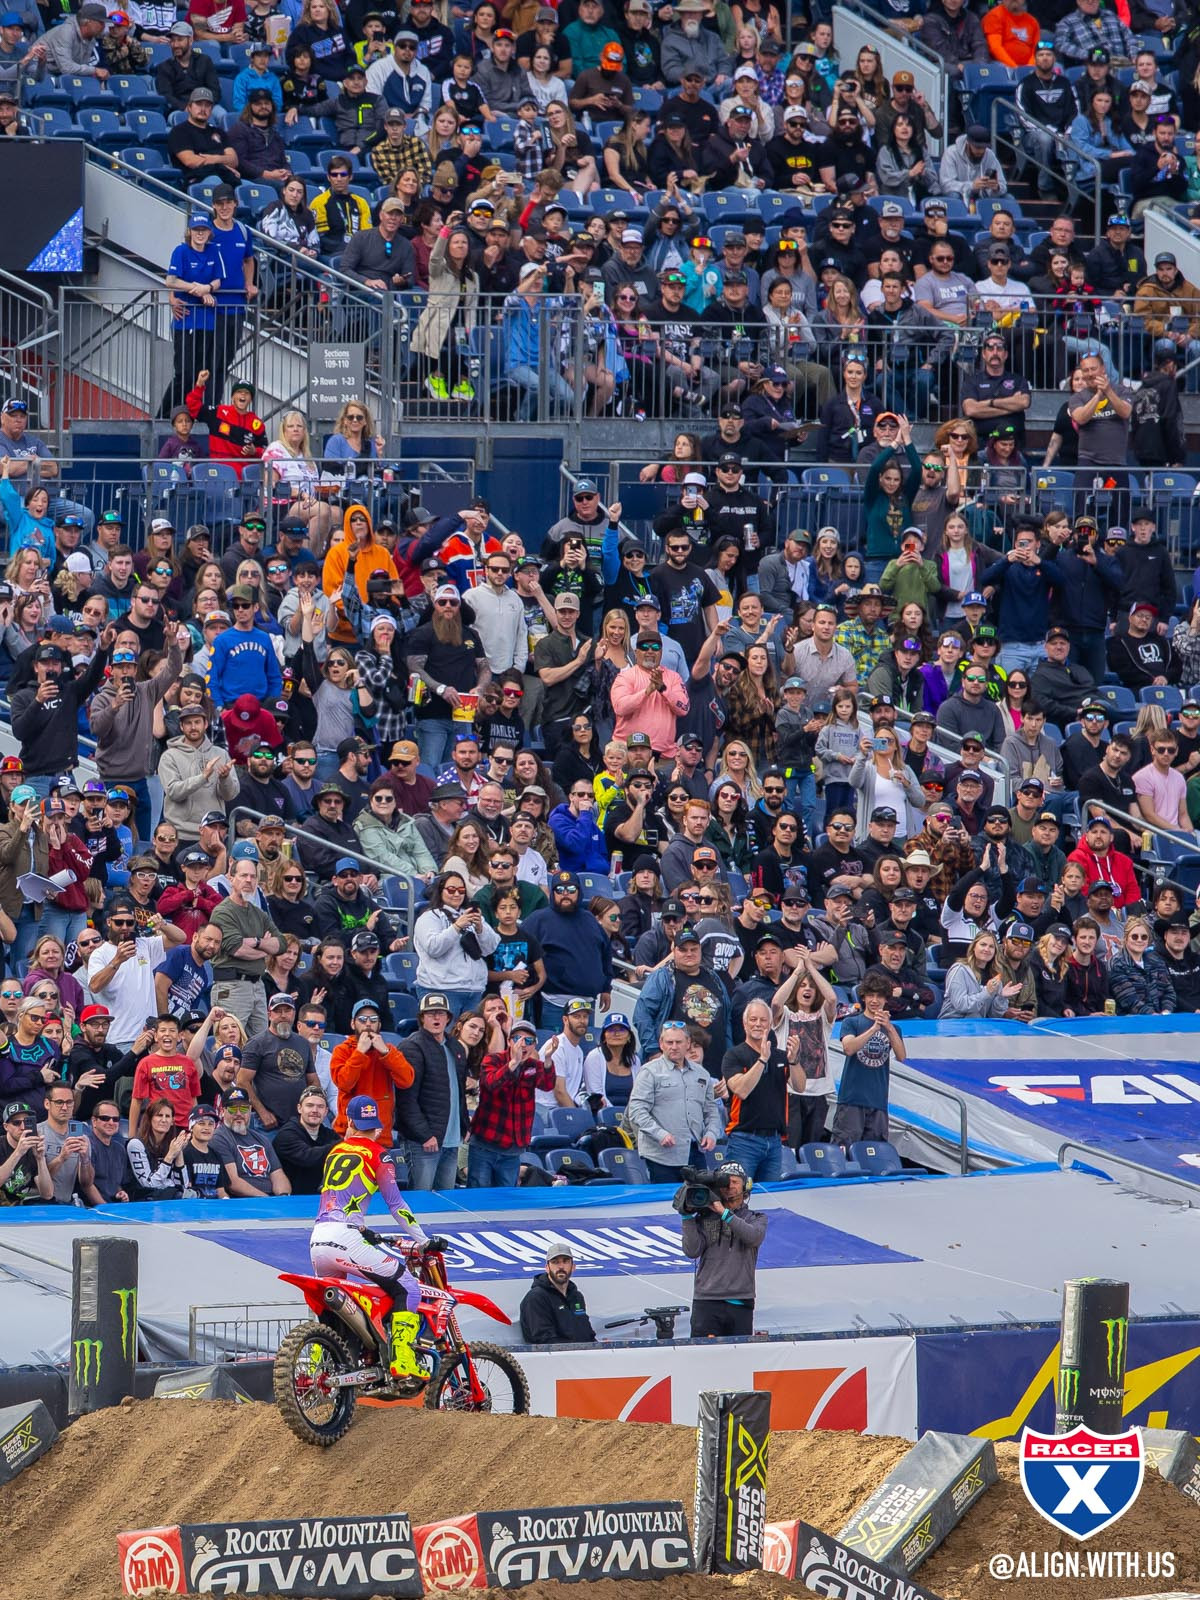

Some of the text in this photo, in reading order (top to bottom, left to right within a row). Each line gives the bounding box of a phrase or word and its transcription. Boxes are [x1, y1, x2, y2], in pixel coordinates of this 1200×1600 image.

[324, 349, 350, 358] Sections
[324, 360, 350, 368] 109-110
[319, 377, 355, 386] Rows 1-23
[319, 395, 338, 403] Rows
[58, 776, 71, 786] 3
[151, 1065, 184, 1073] AMAZING
[130, 1151, 147, 1179] FOX
[192, 1163, 221, 1175] TOMAC
[324, 1152, 363, 1186] 18
[419, 1288, 449, 1299] ONDA
[1089, 1387, 1124, 1400] MONST
[1, 1434, 21, 1452] SUPER
[5, 1440, 22, 1457] MOTO
[6, 1446, 25, 1464] CROSS
[692, 1420, 704, 1559] WORLD CHAMPIONSHIP
[870, 1484, 906, 1523] CROSS
[880, 1484, 916, 1525] MOTO
[892, 1486, 928, 1526] SUPER
[518, 1509, 684, 1544] ROCKY MOUNTAIN
[736, 1484, 751, 1562] SUPER
[749, 1488, 761, 1557] MOTO
[224, 1519, 412, 1557] ROCKY MOUNTAIN
[831, 1545, 891, 1594] ROCKY
